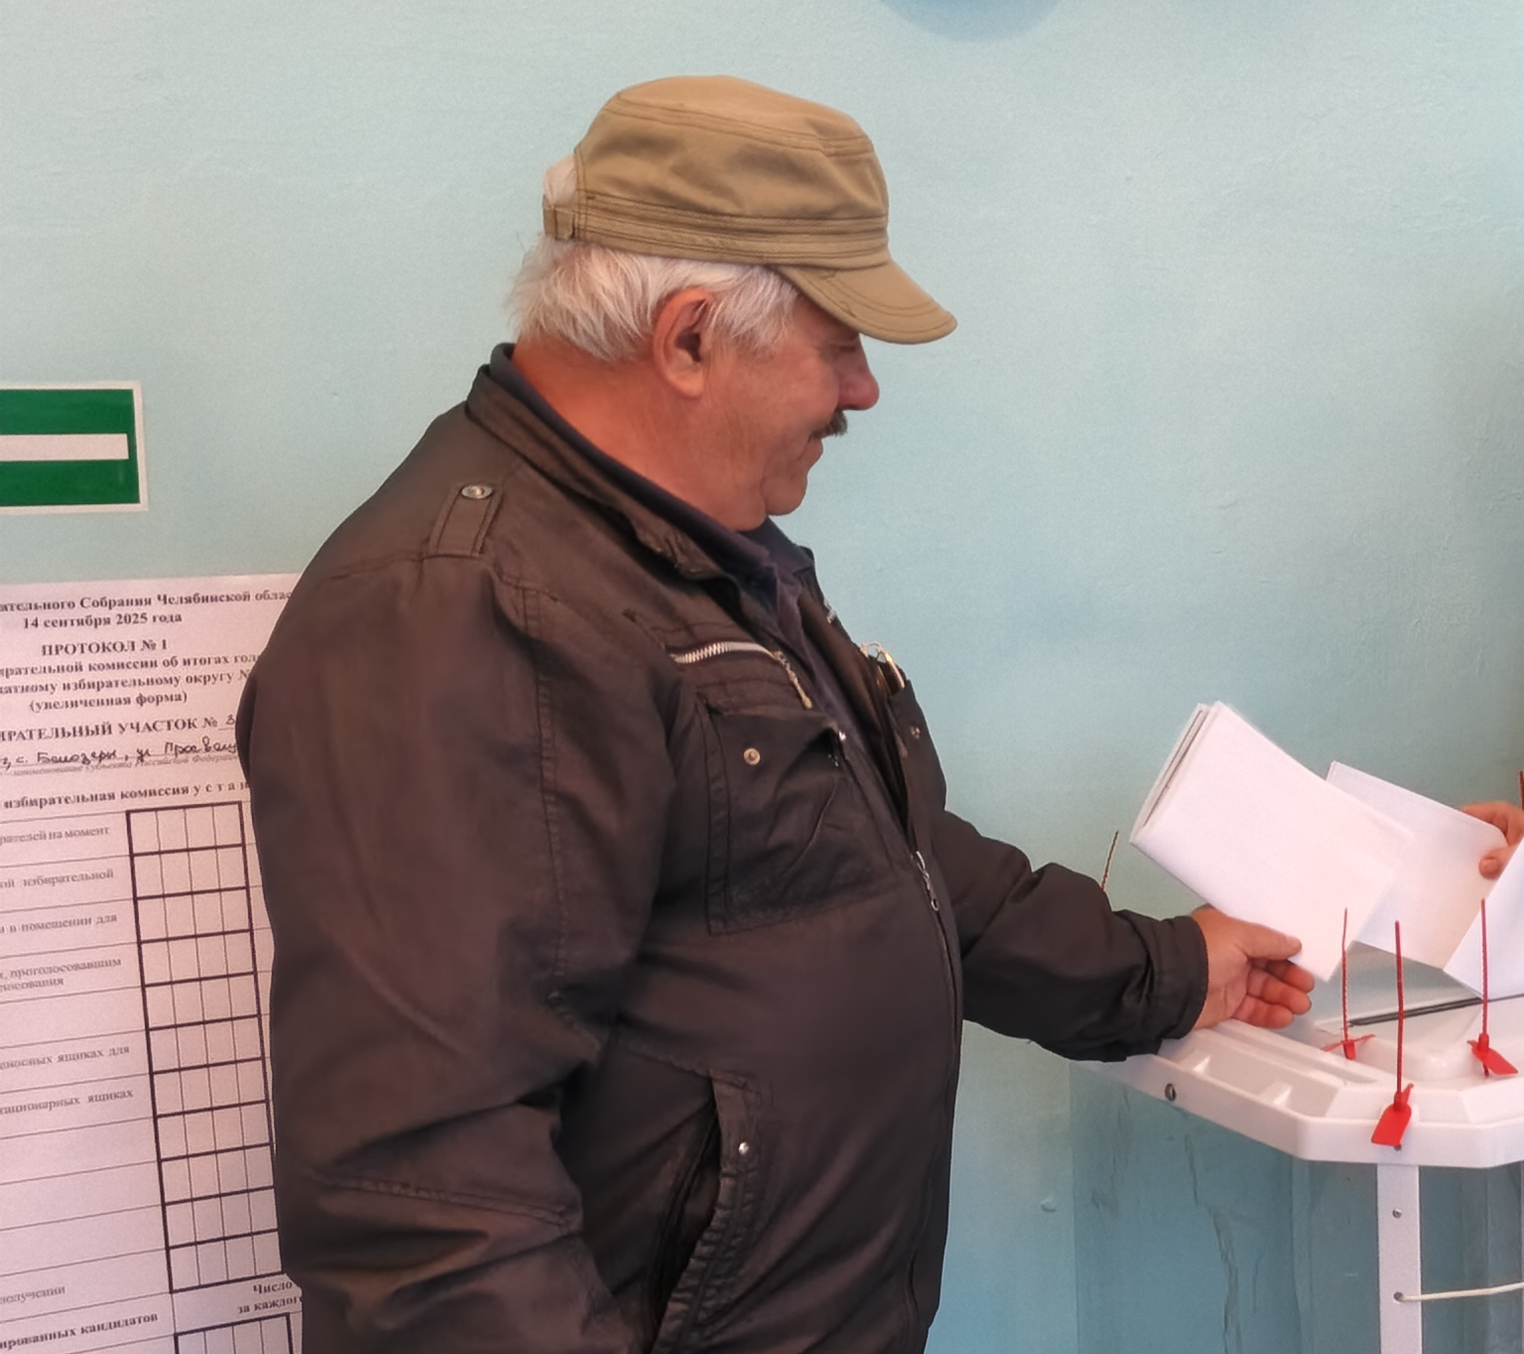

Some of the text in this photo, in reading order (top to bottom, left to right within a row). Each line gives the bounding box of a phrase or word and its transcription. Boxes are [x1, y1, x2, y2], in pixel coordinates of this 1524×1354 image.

[80, 596, 153, 611] Собрания
[157, 591, 251, 605] Челябинской
[23, 612, 182, 629] 14 сентября 2025 года
[41, 639, 167, 656] ПРОТОКОЛ № 1
[88, 659, 158, 672] комиссии
[162, 656, 179, 668] об
[182, 656, 230, 667] итогах
[62, 675, 181, 692] избирательному
[186, 671, 234, 685] округу
[29, 691, 188, 713] (увеличенная форма)
[118, 718, 198, 735] УЧАСТОК
[202, 717, 218, 729] №
[4, 791, 116, 810] избирательная
[120, 785, 190, 800] комиссия
[253, 1281, 293, 1295] Число
[80, 1313, 158, 1335] кандидатов
